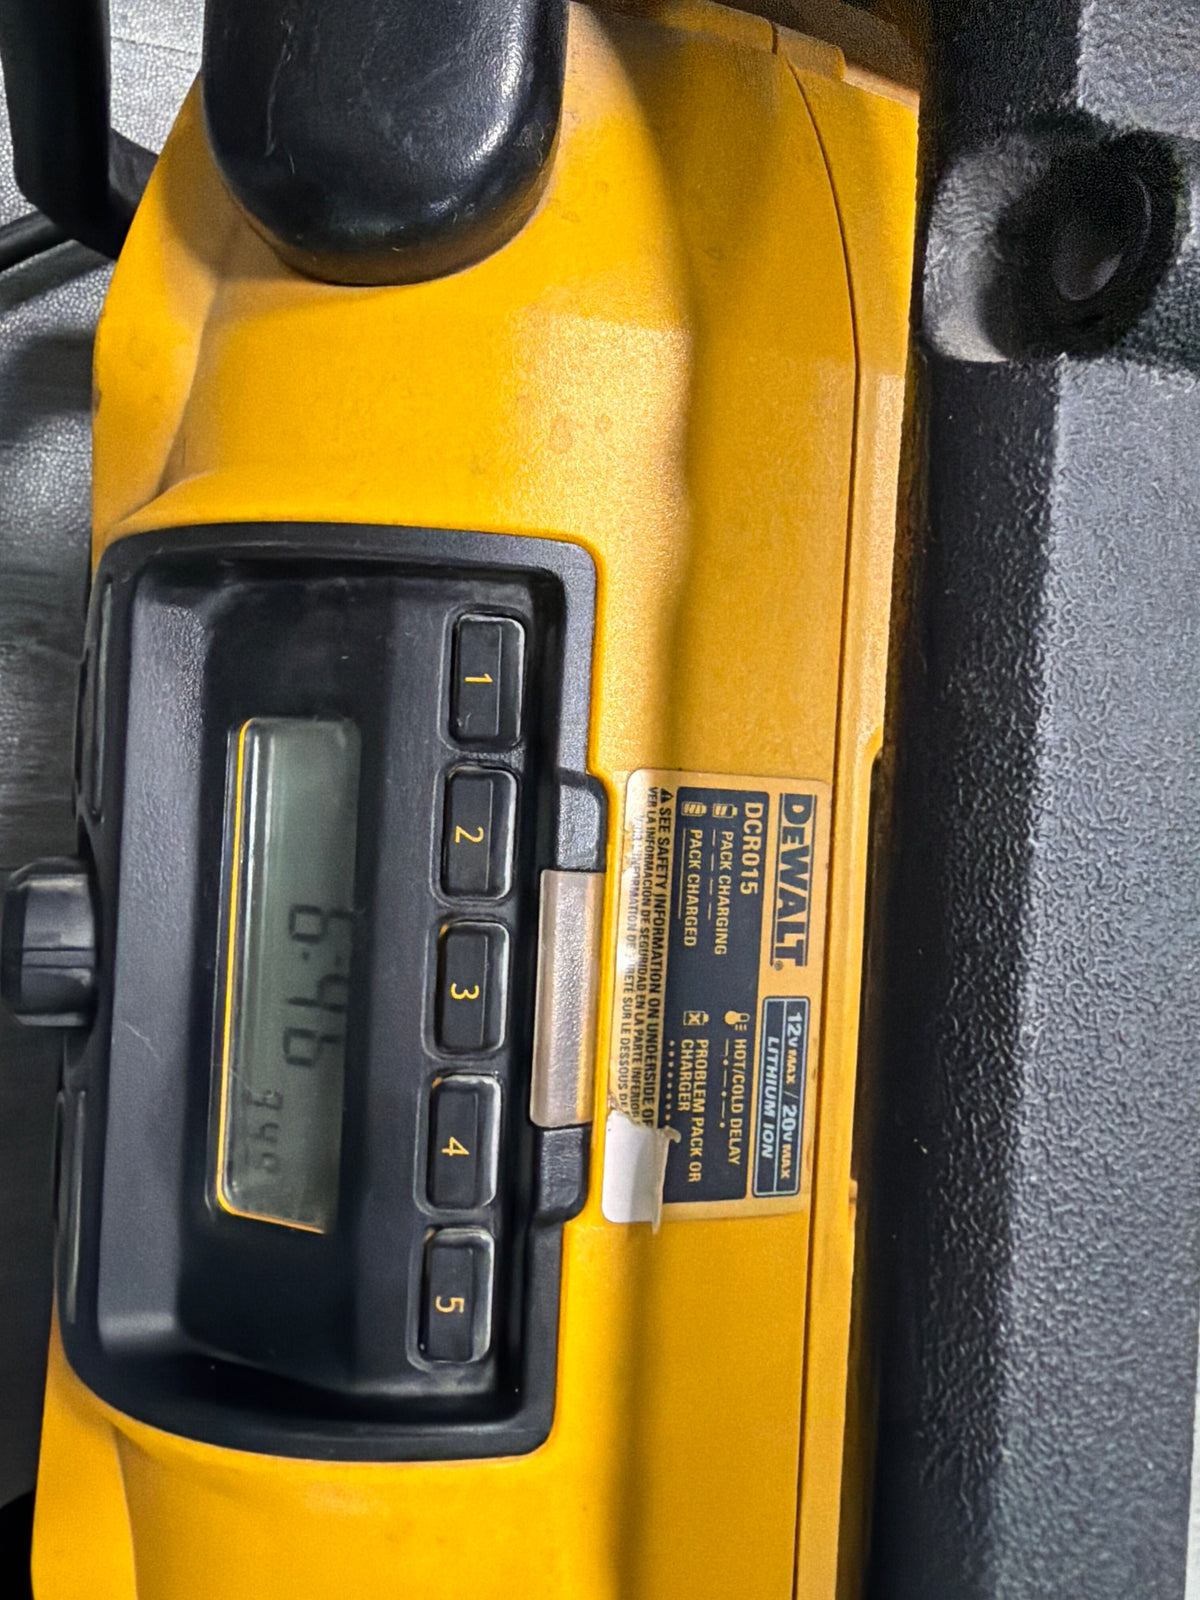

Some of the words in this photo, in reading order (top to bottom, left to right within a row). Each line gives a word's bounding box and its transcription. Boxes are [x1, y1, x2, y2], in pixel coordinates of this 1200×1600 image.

[464, 672, 492, 684] 1
[647, 787, 657, 807] VER
[455, 825, 484, 843] 2
[646, 811, 656, 823] LA
[658, 807, 671, 833] SEE
[655, 837, 669, 890] SAFETY
[689, 829, 703, 869] PACK
[720, 831, 734, 870] PACK
[740, 802, 764, 895] DCR015
[640, 910, 650, 925] DE
[684, 874, 701, 947] CHARGED
[715, 875, 731, 955] CHARGING
[626, 934, 636, 948] DE
[649, 893, 667, 993] INFORMATION
[636, 927, 649, 992] SEGURIDAD
[451, 982, 479, 1000] 3
[622, 997, 634, 1019] SUR
[635, 995, 646, 1013] EN
[647, 998, 661, 1018] ON
[621, 1023, 632, 1034] LE
[634, 1015, 644, 1026] LA
[632, 1029, 643, 1064] PARTE
[642, 1023, 659, 1105] UNDERSIDE
[618, 1040, 630, 1090] DESSOUS
[677, 1039, 694, 1111] CHARGER
[692, 1039, 709, 1113] PROBLEM
[730, 1039, 747, 1114] HOT/COLD
[763, 1036, 779, 1116] LITHIUM
[786, 1049, 797, 1084] MAX
[642, 1109, 655, 1128] OF
[441, 1136, 469, 1156] 4
[690, 1117, 705, 1156] PACK
[728, 1118, 744, 1165] DELAY
[761, 1123, 774, 1159] ION
[688, 1162, 702, 1182] OR
[780, 1144, 791, 1179] MAX
[436, 1295, 464, 1313] 5
